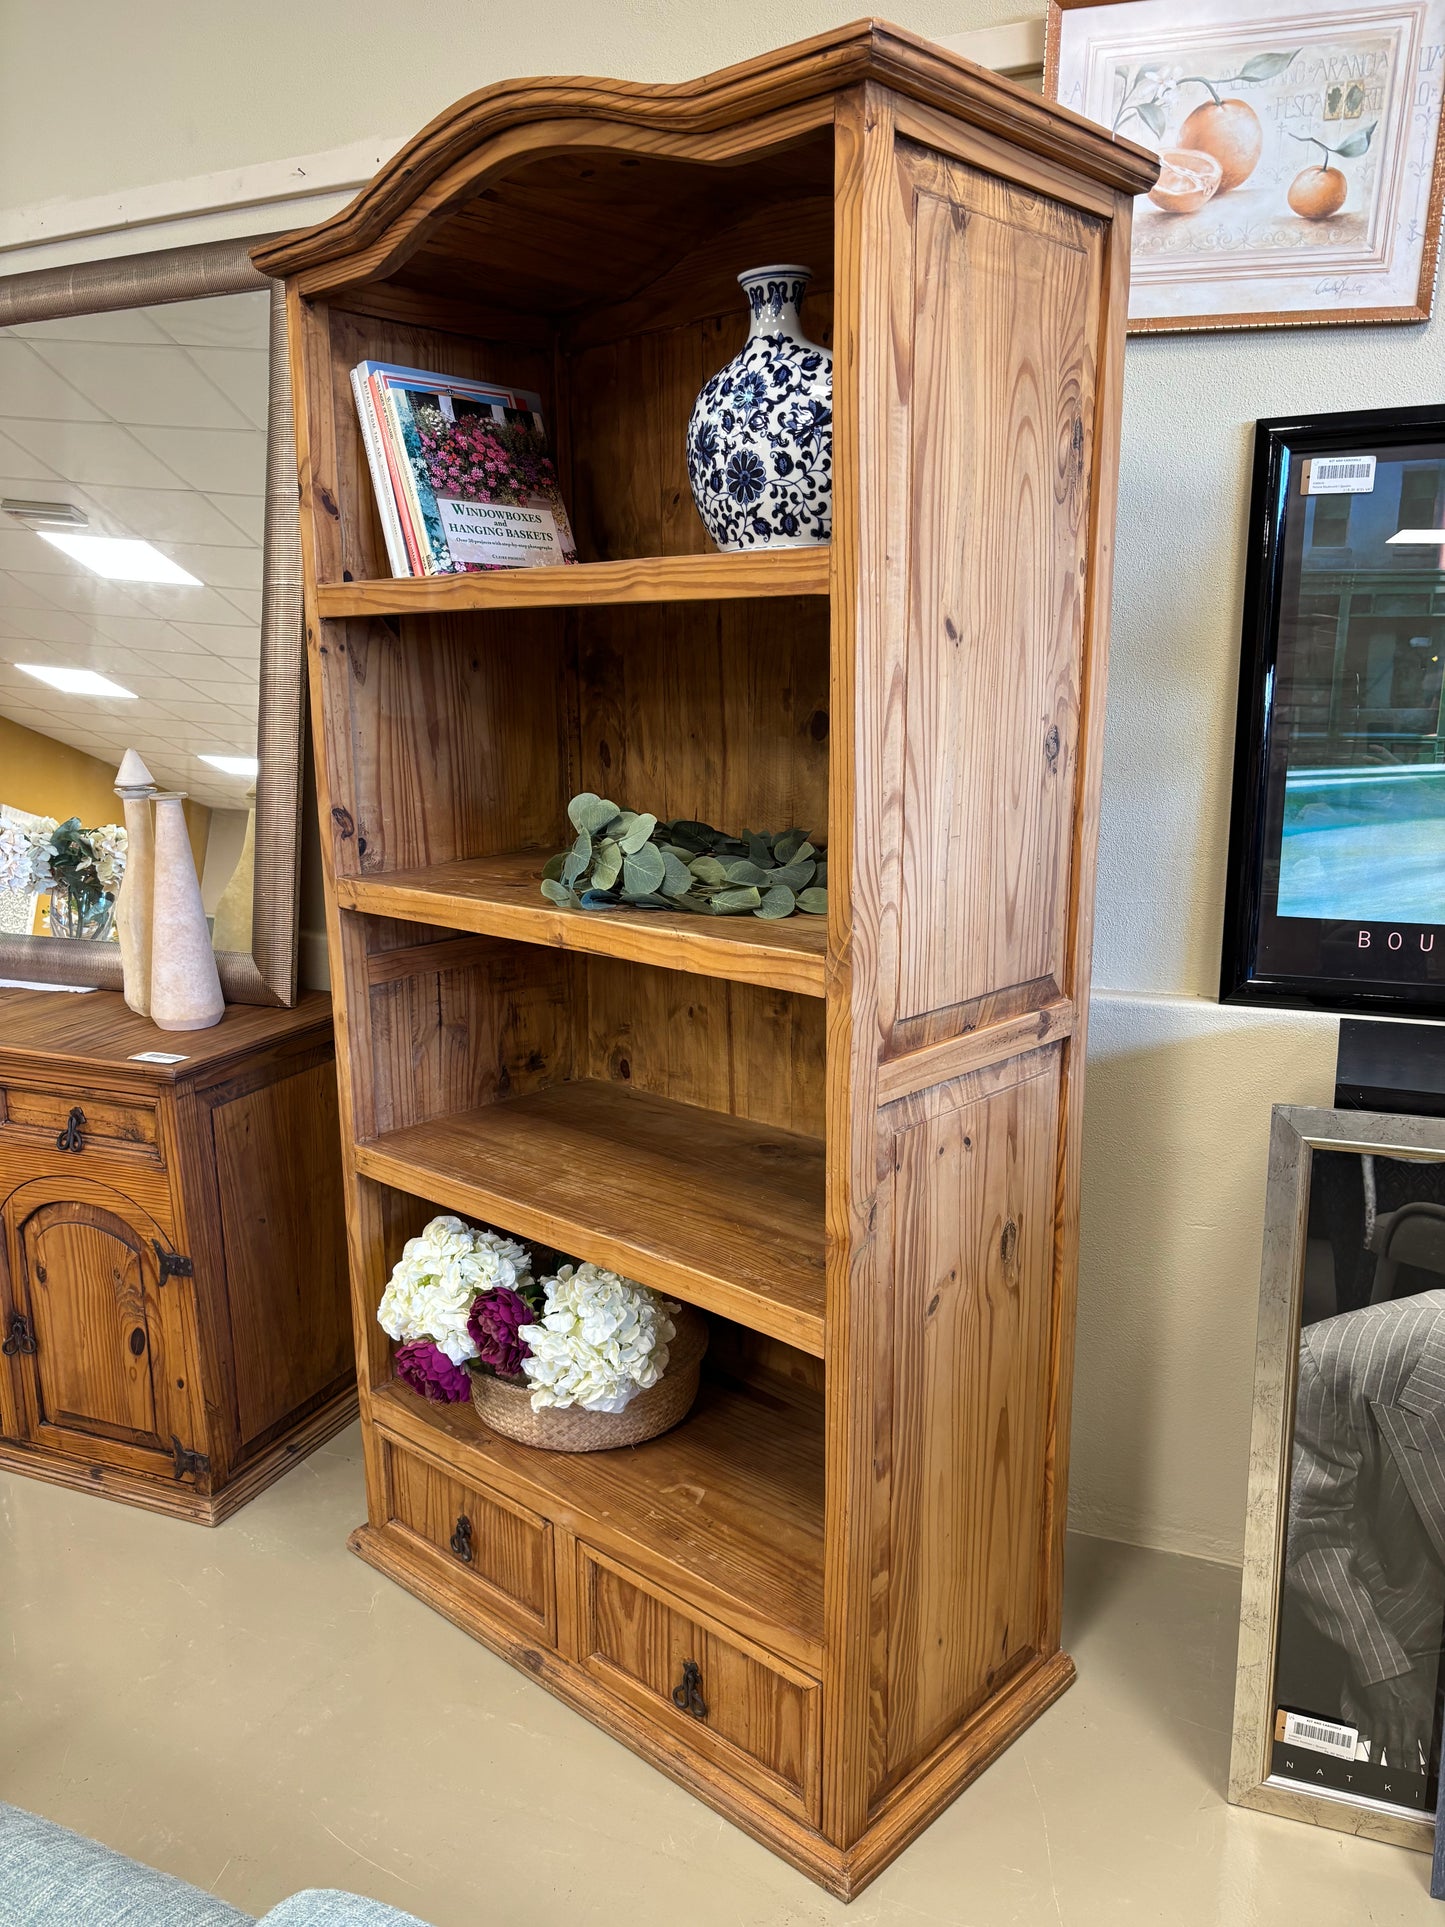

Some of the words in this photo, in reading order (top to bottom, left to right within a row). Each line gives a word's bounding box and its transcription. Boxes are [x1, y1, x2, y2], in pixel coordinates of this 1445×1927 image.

[363, 380, 372, 408] BRITAIN
[369, 410, 377, 429] FROM
[384, 414, 394, 440] ENGLAND
[450, 503, 543, 524] WINDOWBOXES
[448, 523, 504, 537] HANGING
[505, 528, 554, 542] BASKETS
[1357, 930, 1435, 952] BOU
